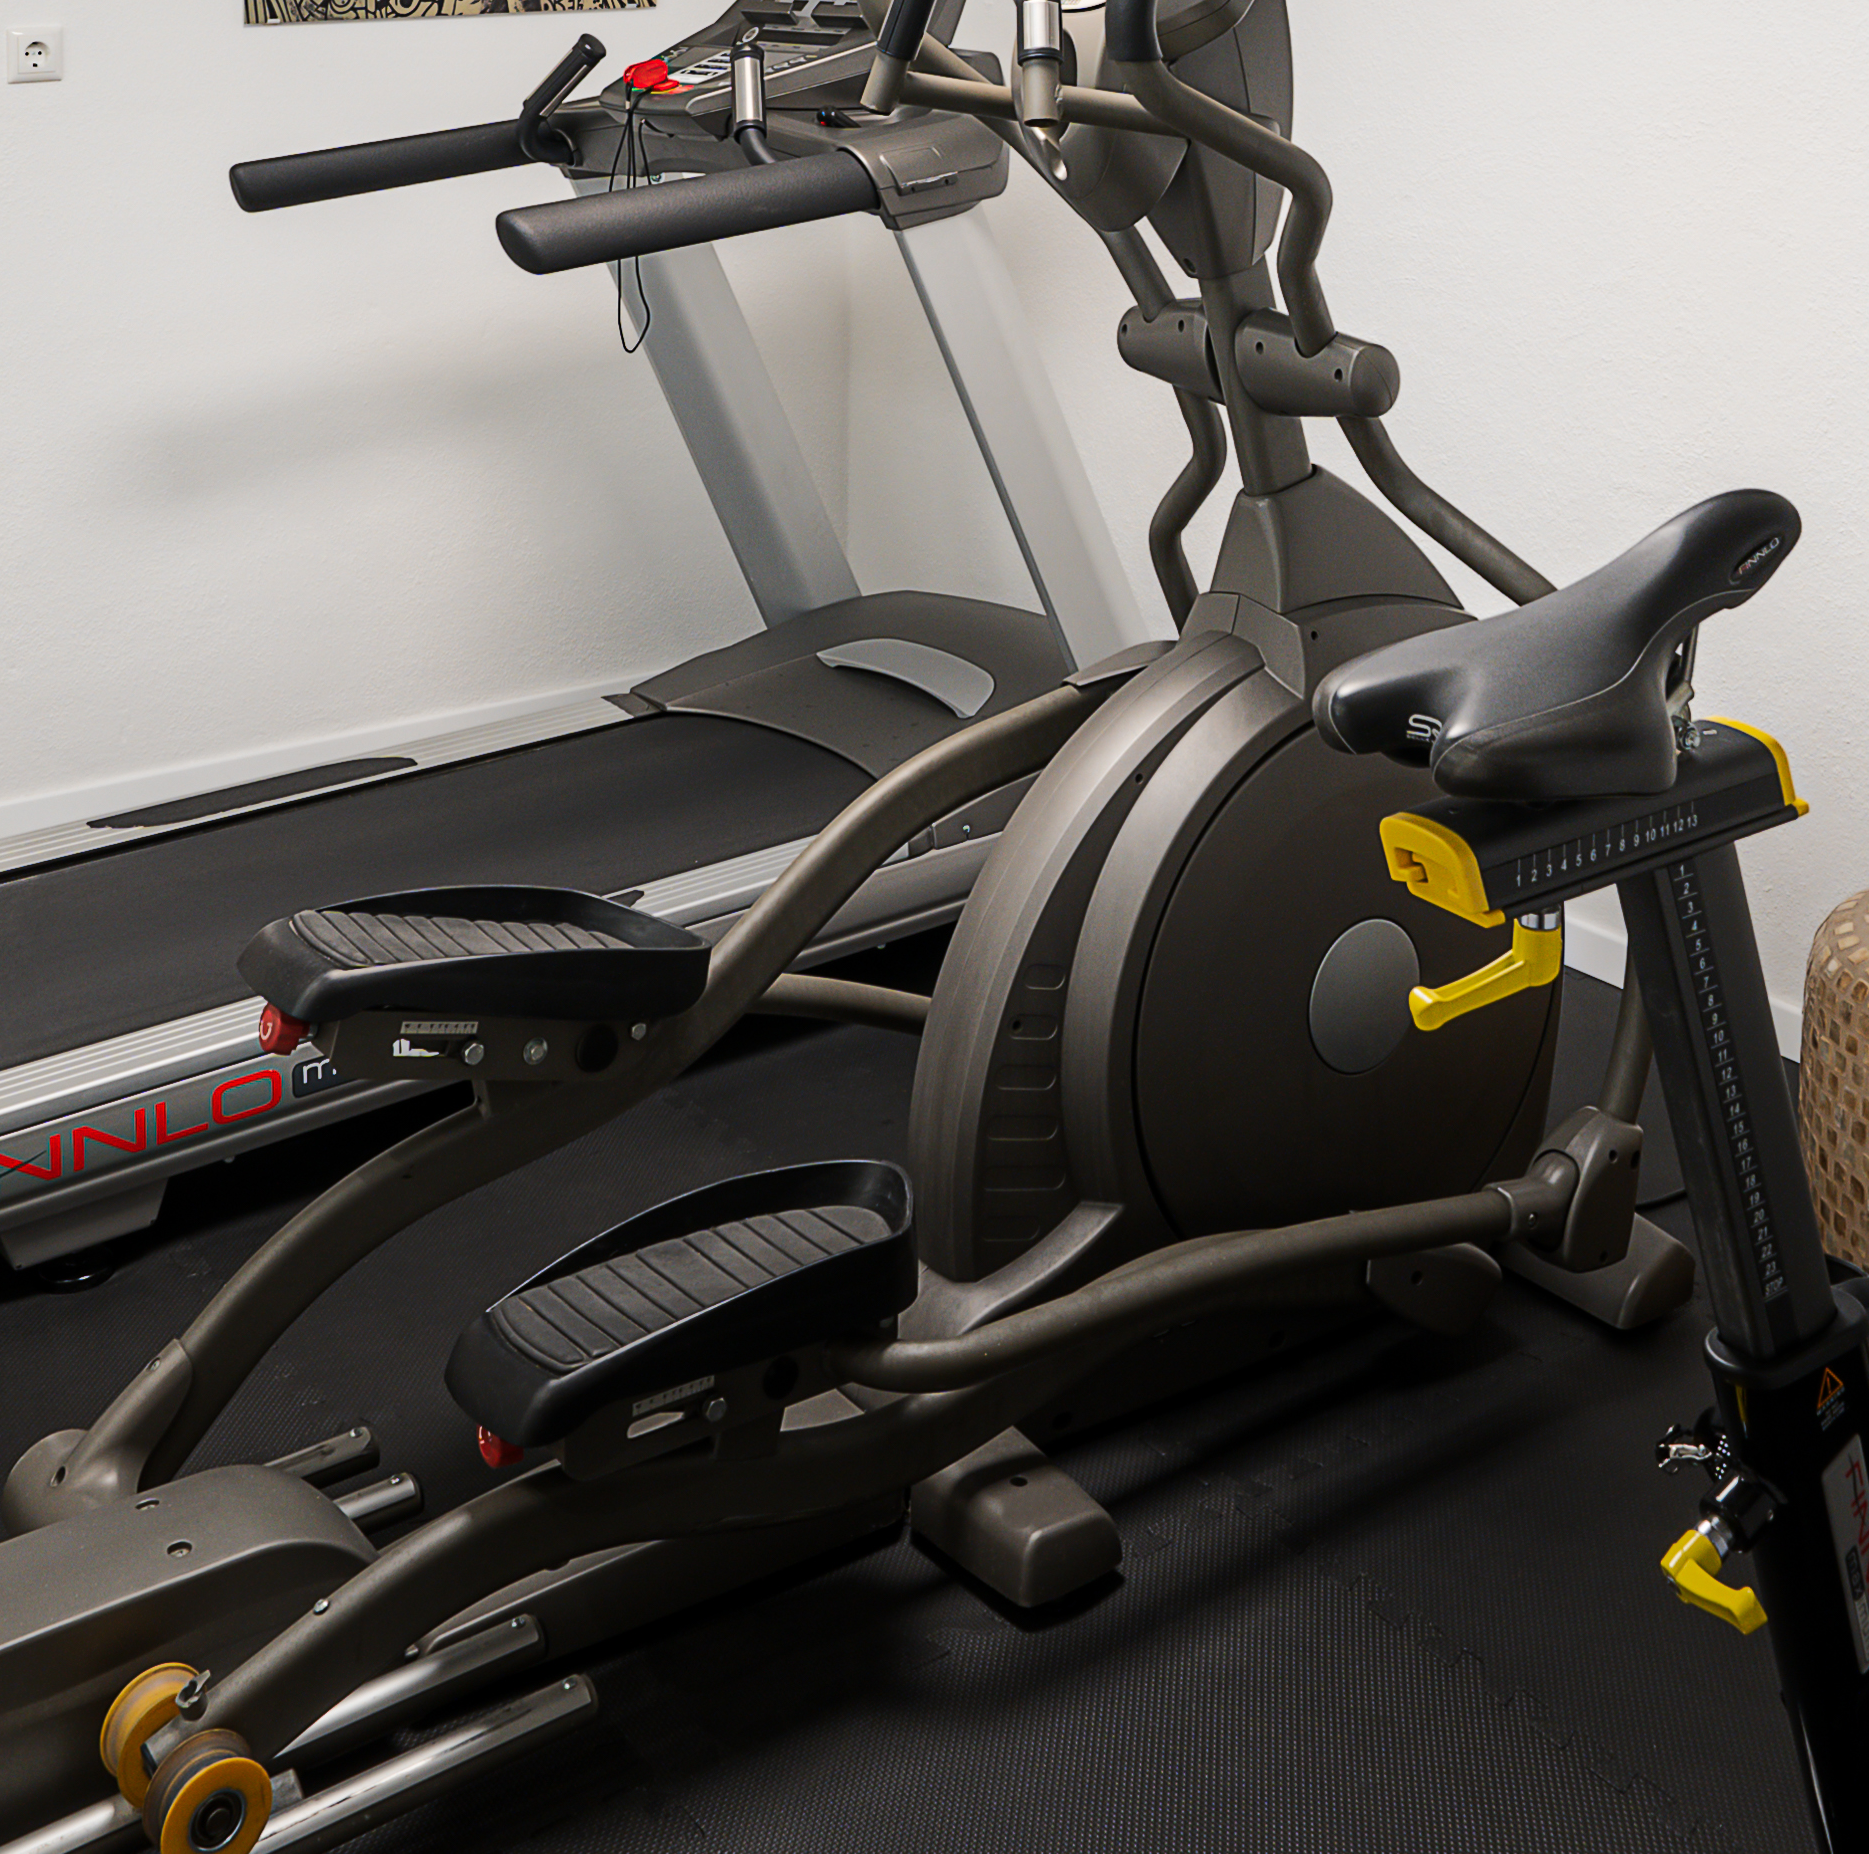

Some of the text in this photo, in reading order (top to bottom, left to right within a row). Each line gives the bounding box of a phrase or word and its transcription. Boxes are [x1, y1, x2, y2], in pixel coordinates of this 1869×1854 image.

[1516, 814, 1698, 887] 1 2 3 4 5 6 7 8 9 10 11 12 13
[1680, 864, 1685, 876] 1
[1683, 883, 1690, 895] 2
[1687, 901, 1694, 913] 3
[1691, 920, 1698, 931] 4
[1696, 939, 1702, 951] 5
[1699, 957, 1706, 970] 6
[1703, 976, 1709, 989] 7
[1708, 994, 1714, 1006] 8
[1712, 1013, 1718, 1026] 9
[1713, 1029, 1724, 1044] 10
[1718, 1049, 1727, 1062] 11
[1721, 1066, 1732, 1081] 12
[1726, 1085, 1736, 1099] 13
[1730, 1103, 1740, 1117] 14
[1733, 1121, 1744, 1135] 15
[1737, 1139, 1748, 1153] 16
[1741, 1156, 1751, 1170] 17
[1746, 1174, 1756, 1188] 18
[1750, 1191, 1760, 1205] 19
[1754, 1209, 1764, 1223] 20
[1758, 1226, 1768, 1240] 21
[1761, 1243, 1772, 1257] 22
[1765, 1261, 1776, 1275] 23
[1765, 1277, 1784, 1296] STOP
